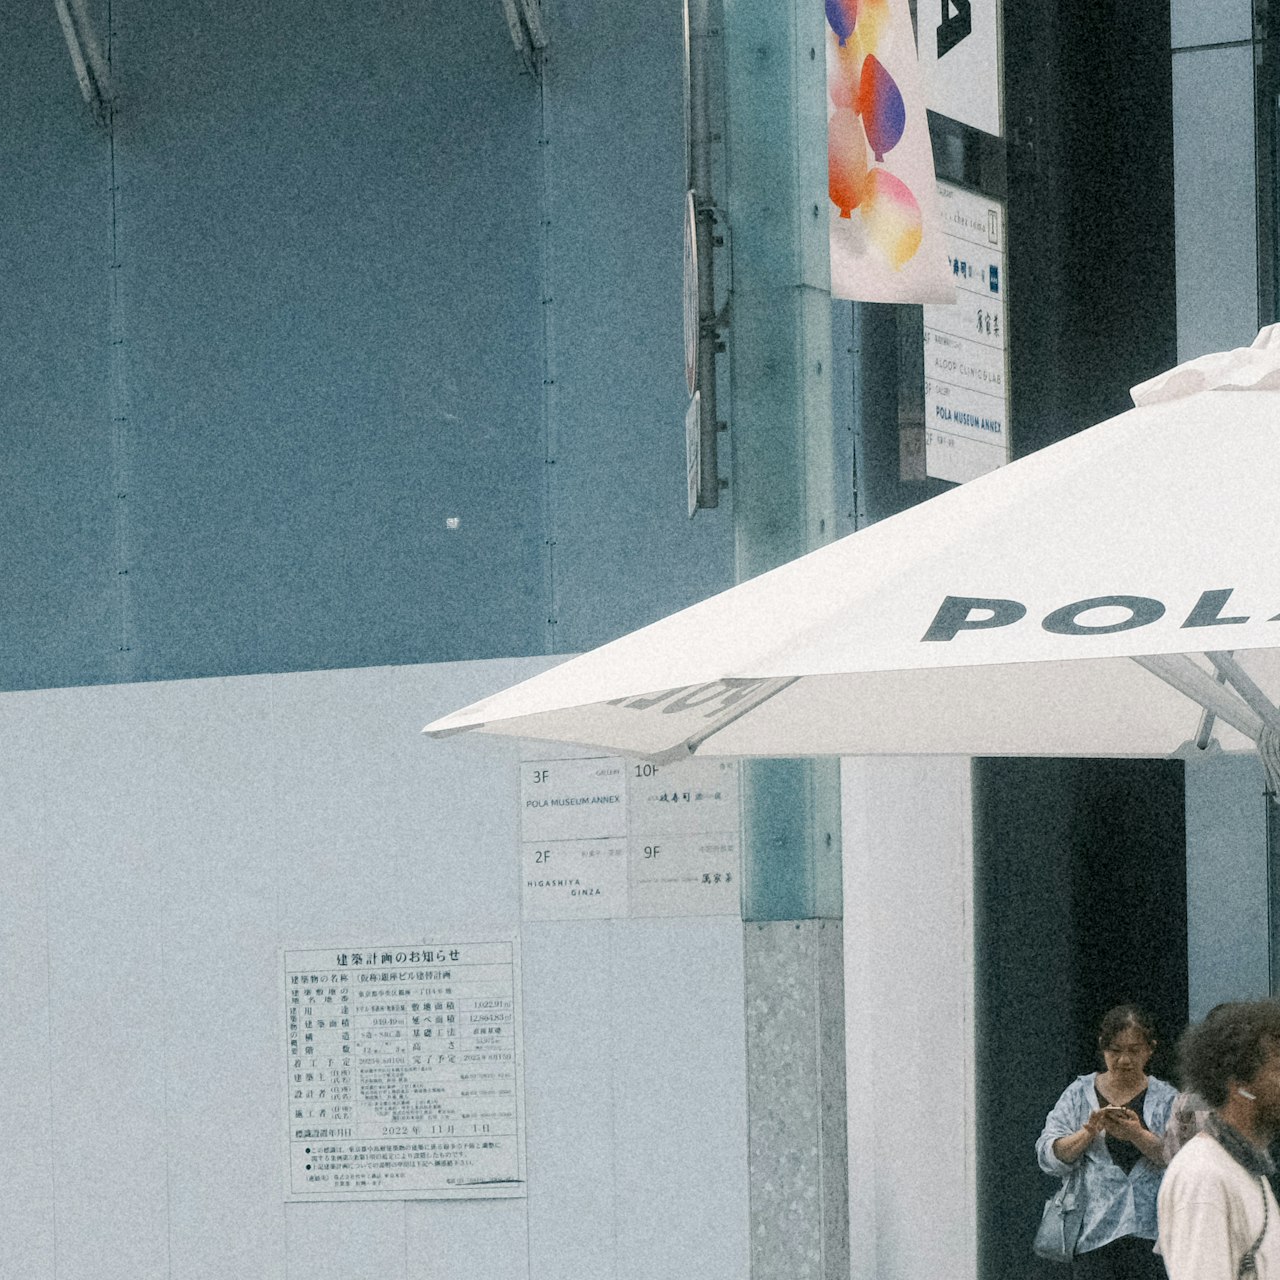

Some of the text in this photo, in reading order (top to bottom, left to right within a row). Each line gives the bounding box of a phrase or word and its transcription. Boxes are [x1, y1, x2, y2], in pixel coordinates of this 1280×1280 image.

[936, 405, 1002, 433] POLA MUSEUM ANNEX
[921, 588, 1280, 642] POL
[533, 770, 549, 783] 3F
[526, 795, 620, 808] POLA MUSEUM ANNEX
[535, 850, 551, 863] 2F
[643, 846, 661, 858] 9F
[527, 879, 580, 887] HIGASHIYA
[336, 950, 460, 966] 建築計画のお知らせ
